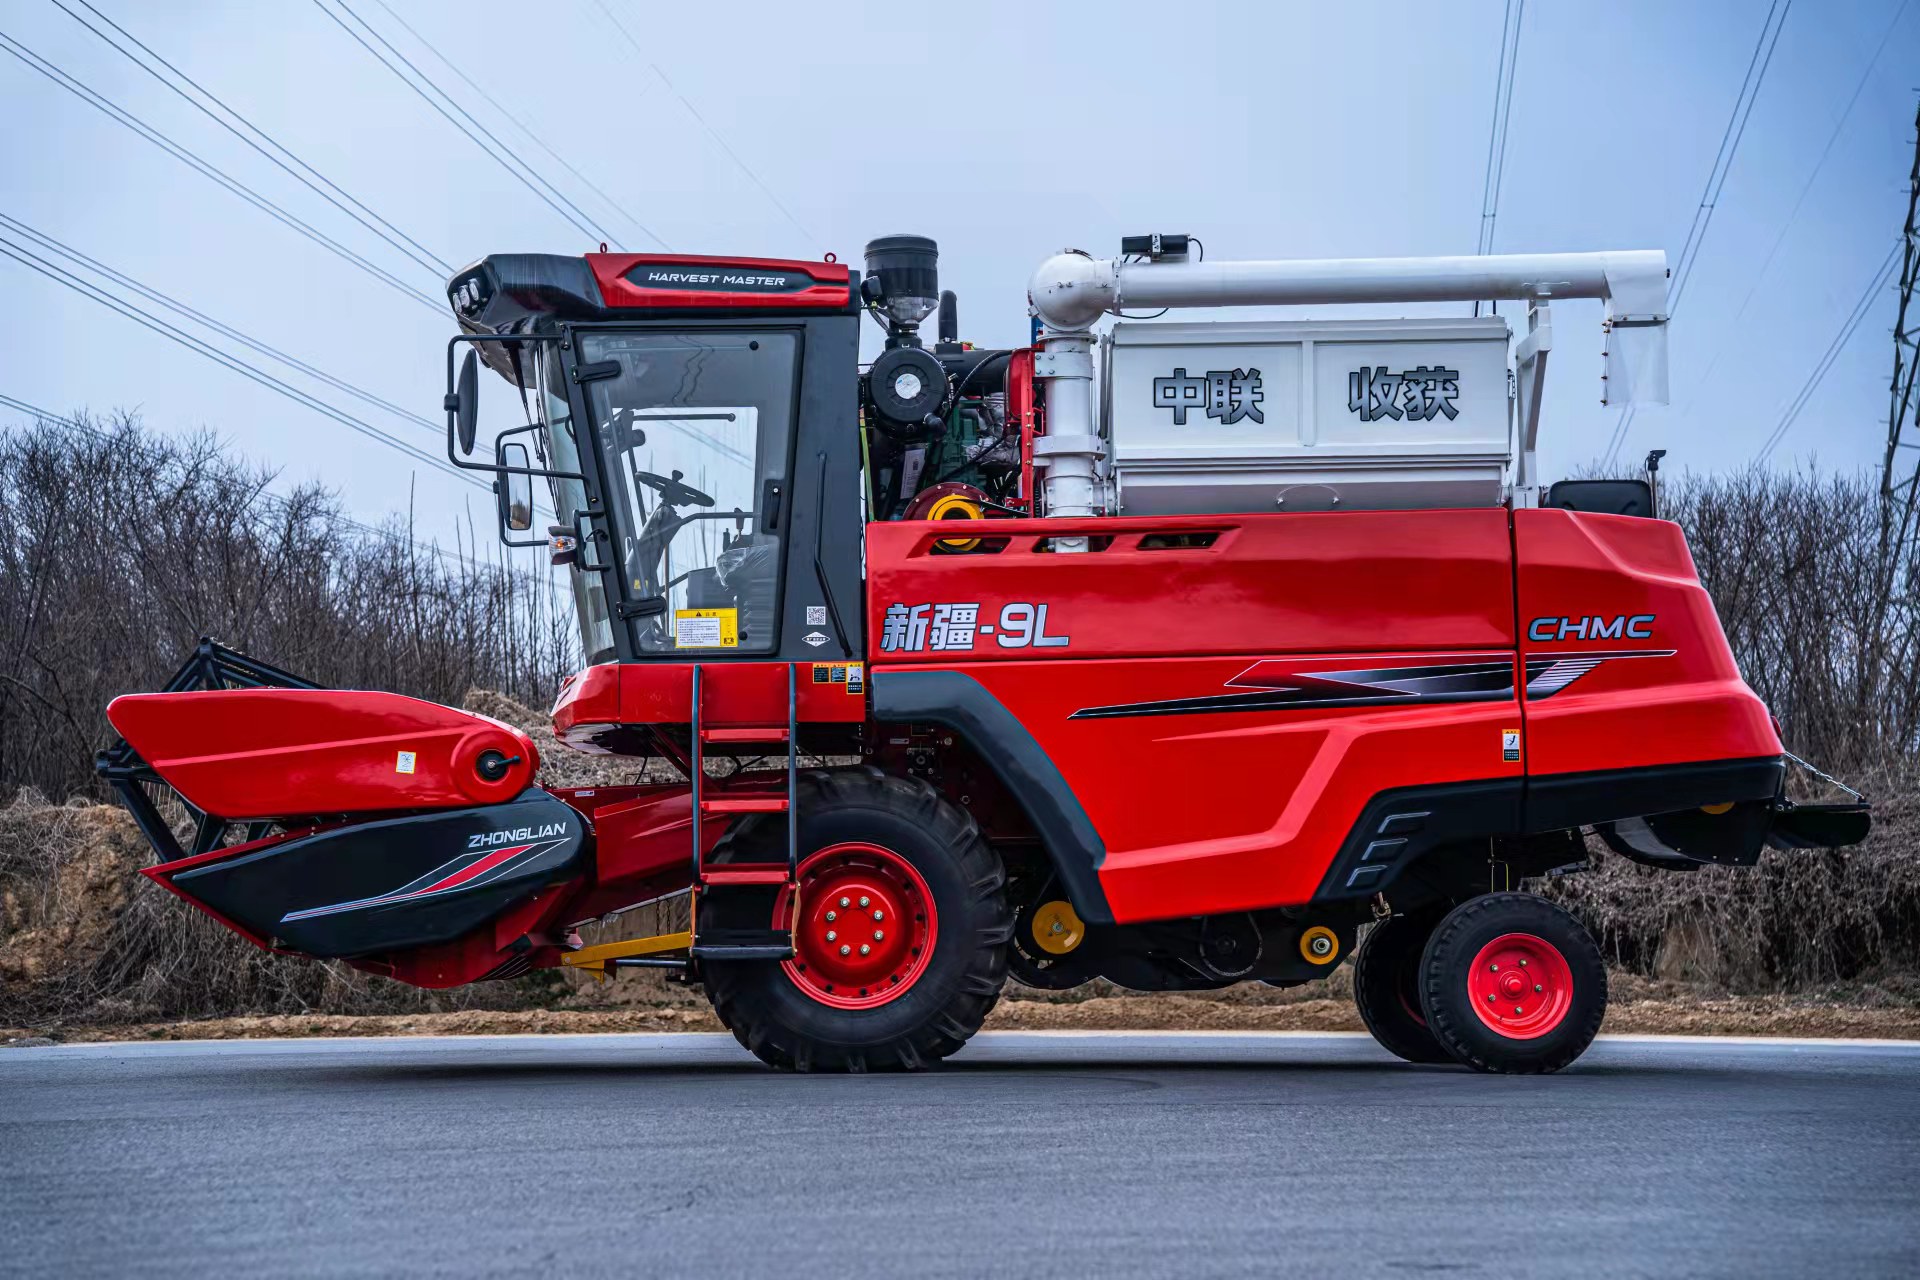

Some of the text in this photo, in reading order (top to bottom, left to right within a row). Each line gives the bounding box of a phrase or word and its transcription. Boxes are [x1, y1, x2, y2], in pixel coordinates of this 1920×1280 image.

[648, 272, 786, 286] HARVEST MASTER
[1153, 366, 1459, 425] 中联 收获
[880, 602, 1070, 652] 新疆-9L
[1528, 614, 1657, 642] CHMC
[468, 822, 567, 848] ZHONGLIAN
